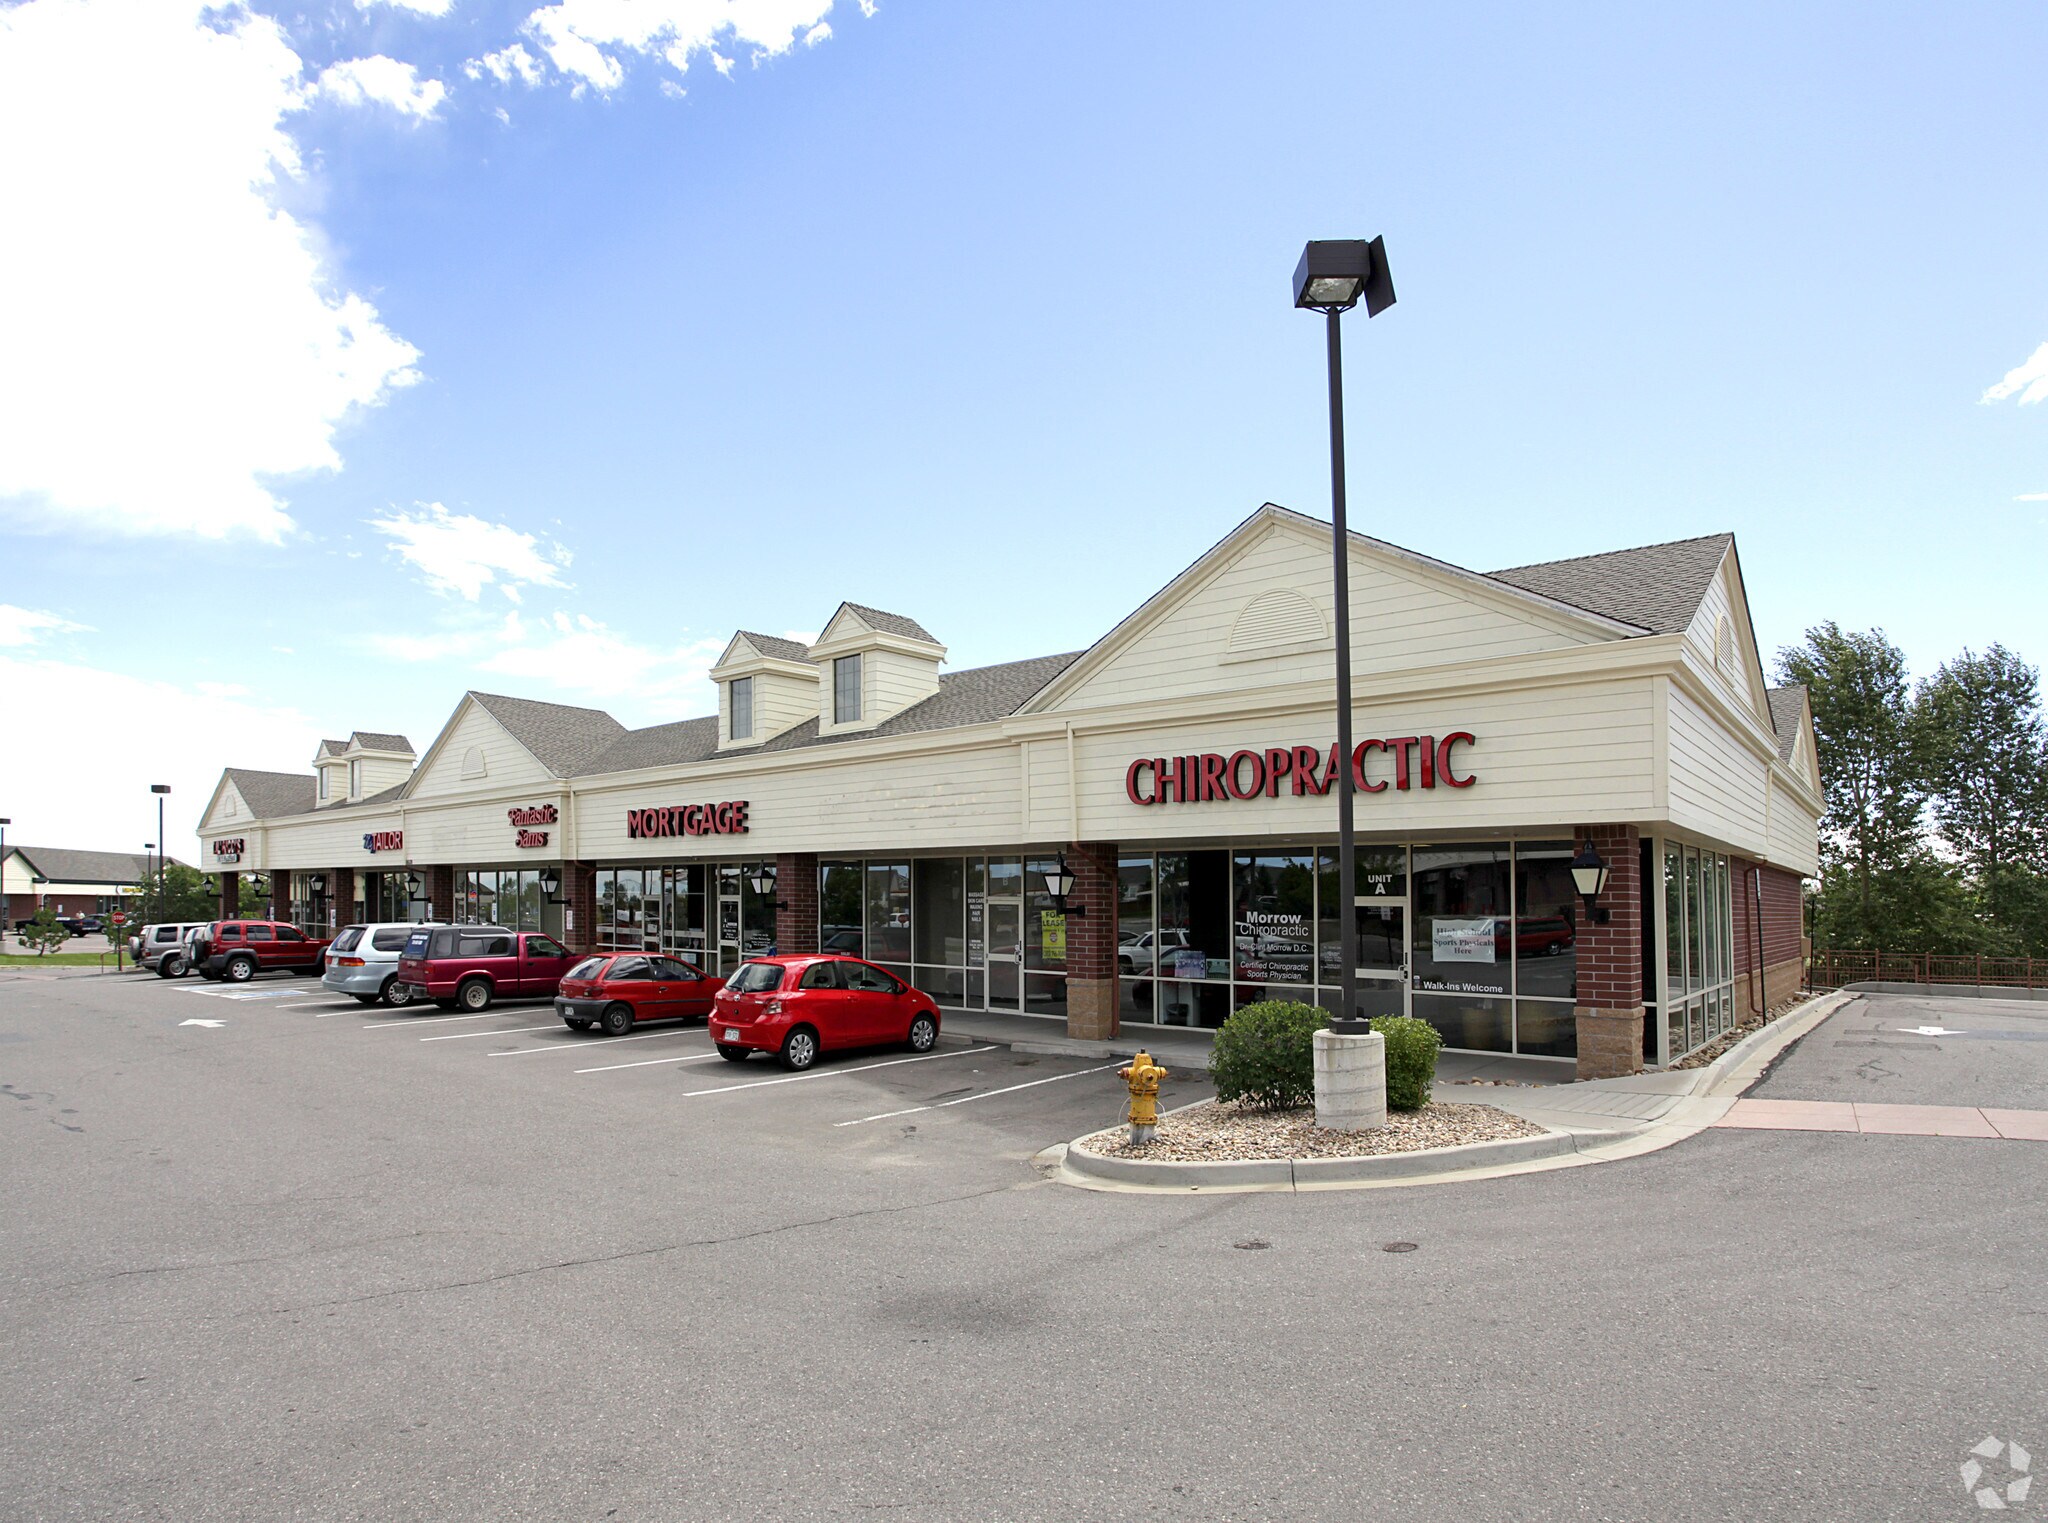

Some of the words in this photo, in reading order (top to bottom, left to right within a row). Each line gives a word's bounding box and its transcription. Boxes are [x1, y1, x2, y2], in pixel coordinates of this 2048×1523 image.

[1126, 731, 1477, 806] CHIROPRACTIC
[508, 803, 558, 826] Fantastic
[627, 800, 750, 839] MORTGAGE
[372, 831, 403, 850] TAILOR
[515, 829, 549, 848] Sams
[1367, 874, 1393, 883] UNIT
[1375, 883, 1386, 894] A
[1246, 911, 1301, 923] Morrow
[1042, 919, 1065, 927] LEASE
[1240, 924, 1309, 936] Chiropractic
[1266, 943, 1292, 952] Morrow
[1293, 944, 1309, 952] D.C.
[1433, 938, 1458, 947] Sports
[1459, 938, 1494, 947] Physicals
[1454, 947, 1472, 955] Here
[1240, 960, 1267, 969] Certified
[1268, 961, 1309, 971] Chiropractic
[1247, 969, 1268, 979] Sports
[1269, 970, 1302, 980] Physician
[1423, 981, 1460, 991] Walk-Ins
[1462, 983, 1503, 993] Welcome
